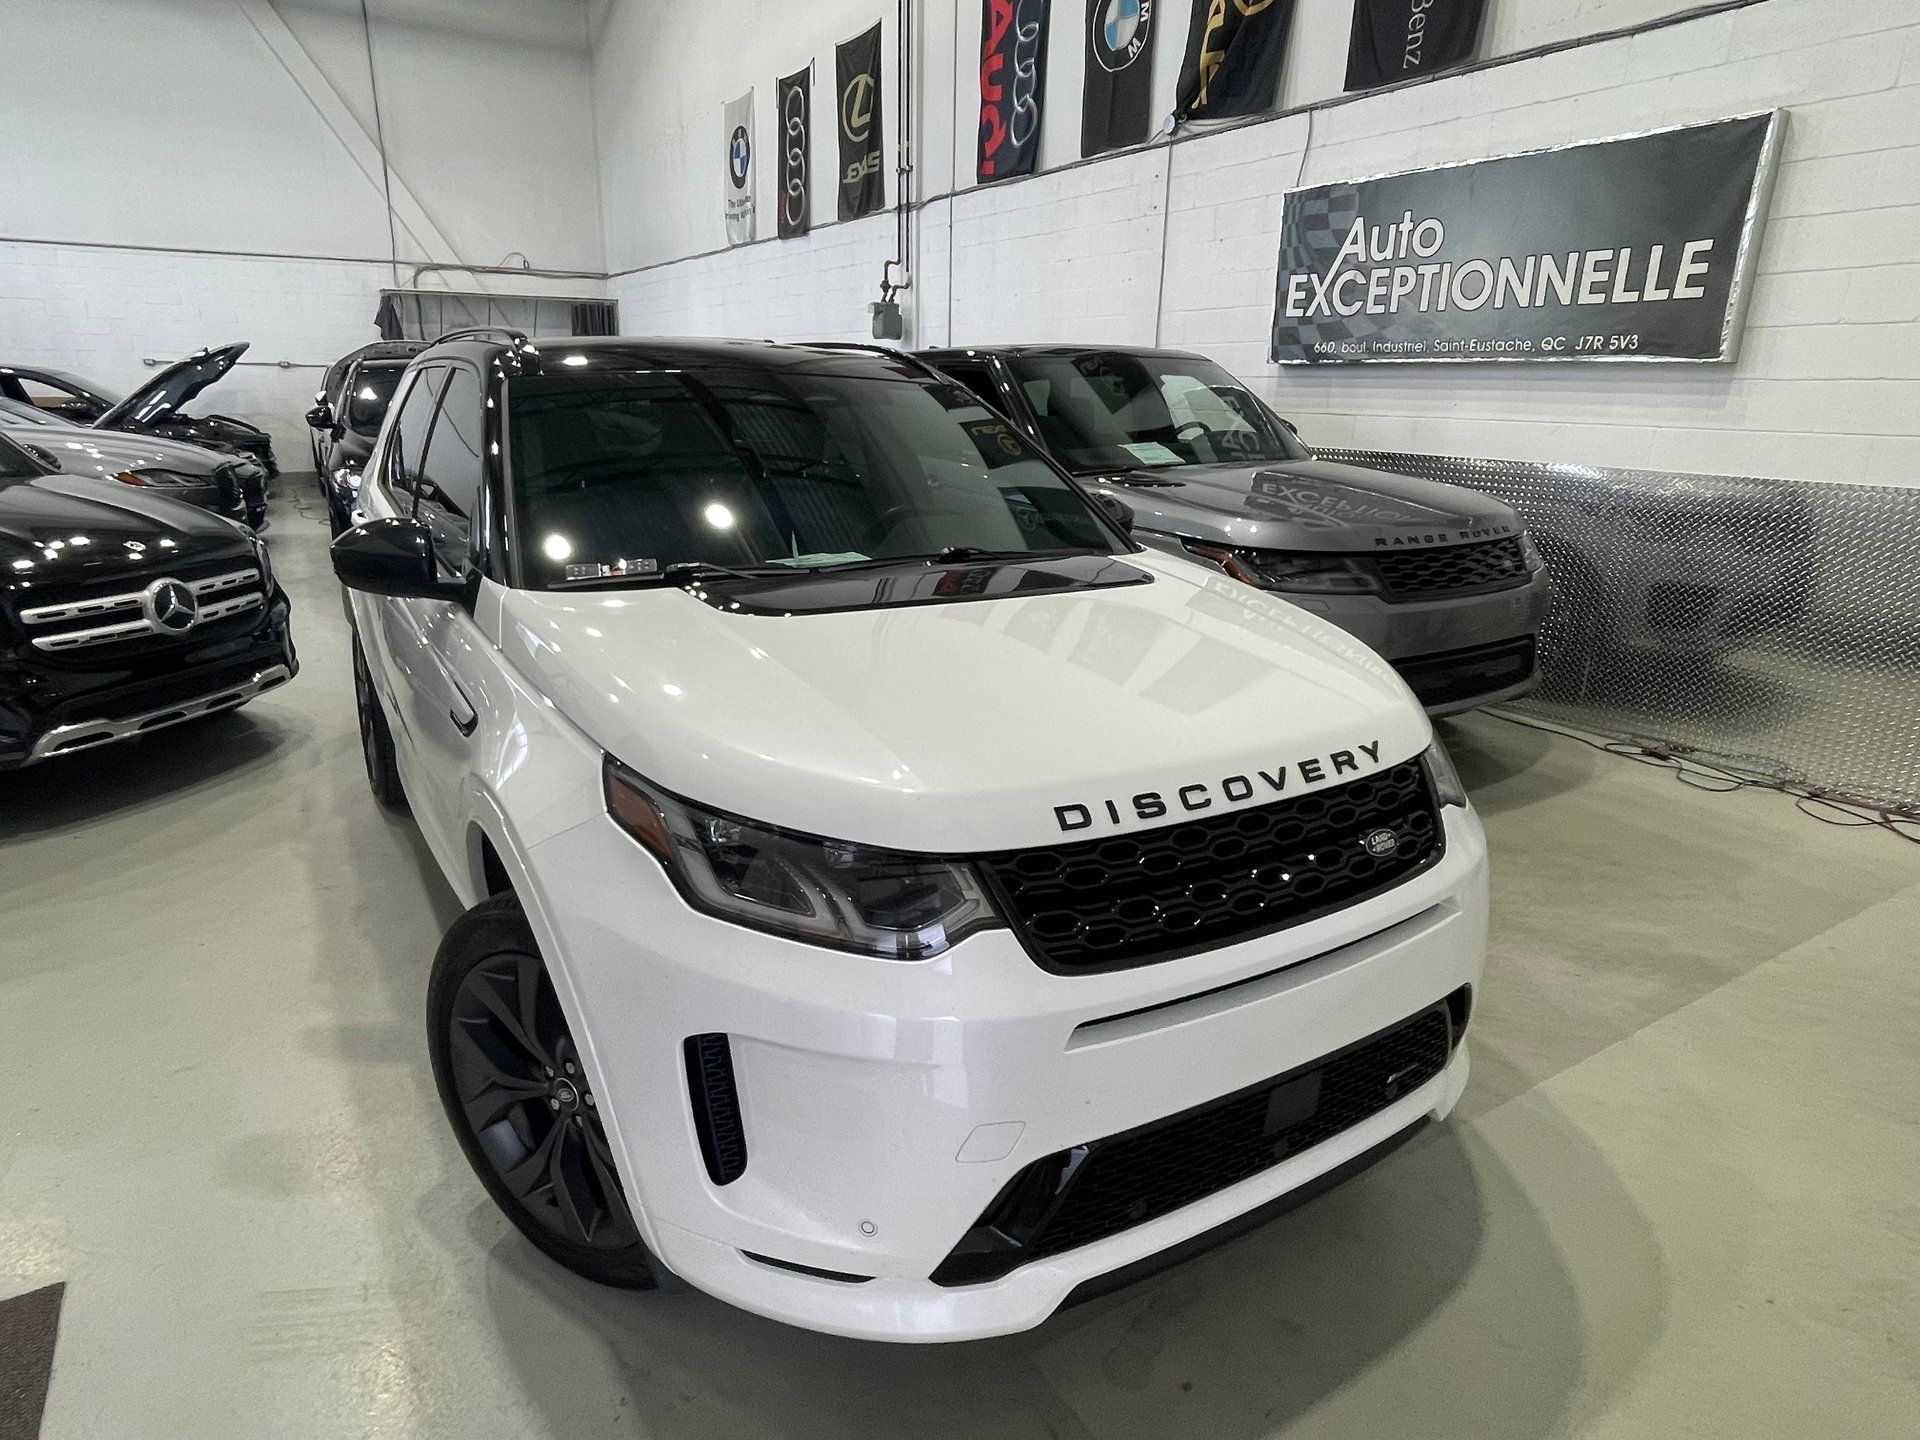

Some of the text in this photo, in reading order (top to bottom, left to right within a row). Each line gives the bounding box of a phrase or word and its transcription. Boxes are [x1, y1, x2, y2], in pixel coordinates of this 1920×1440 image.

[1336, 209, 1445, 263] Auto
[1285, 239, 1714, 318] EXCEPTIONNELLE
[1433, 337, 1536, 353] Saint-Eustache,
[1541, 336, 1567, 351] QC
[1574, 335, 1604, 351] J7R
[1608, 334, 1639, 350] 5V3
[1374, 525, 1511, 547] RANGE ROVER
[1053, 739, 1381, 832] DISCOVERY
